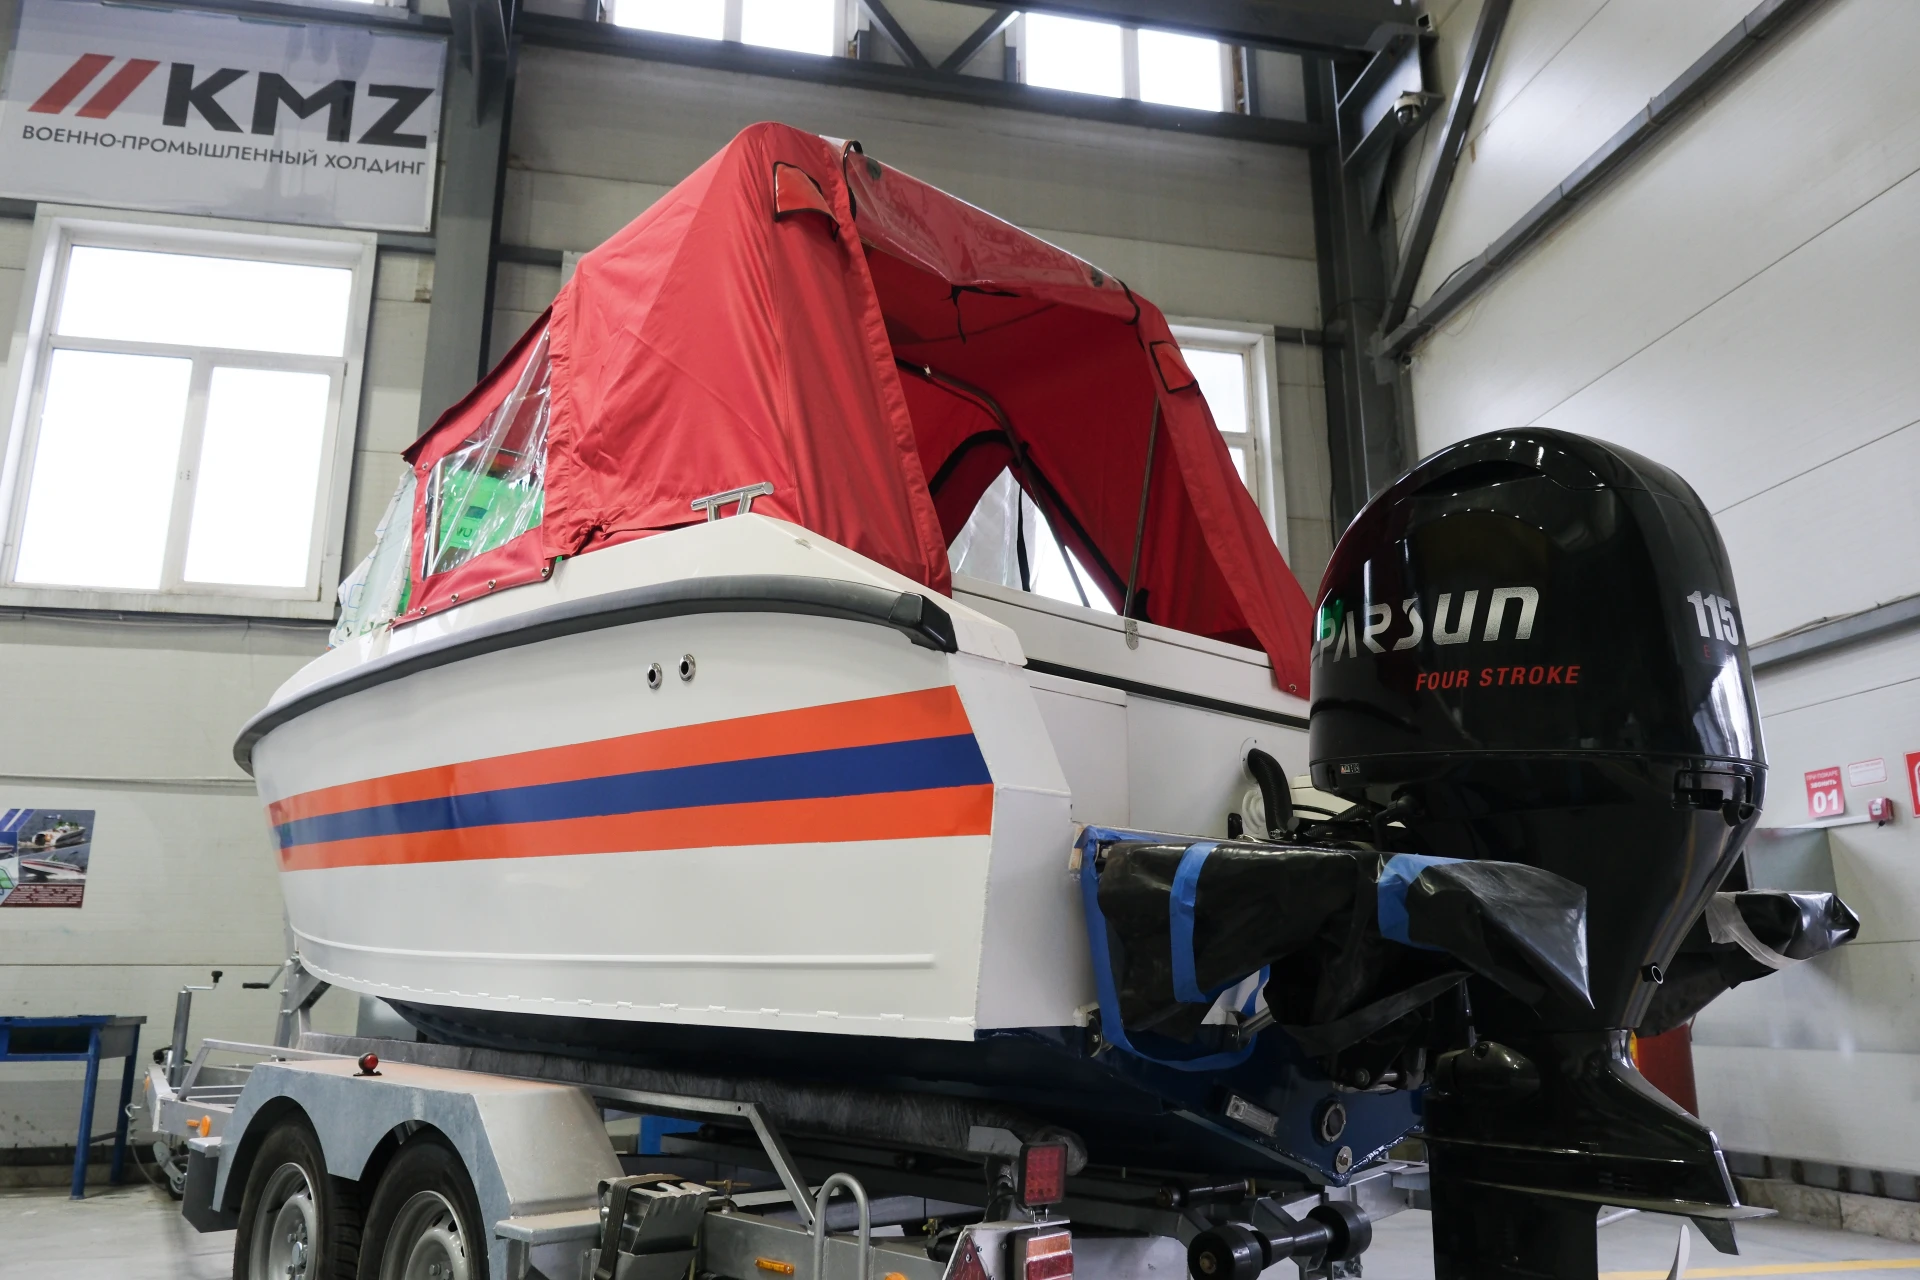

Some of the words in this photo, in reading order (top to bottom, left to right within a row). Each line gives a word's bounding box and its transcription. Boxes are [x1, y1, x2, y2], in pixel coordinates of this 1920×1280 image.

[162, 62, 436, 149] KMZ
[22, 125, 318, 167] ВОЕННО-ПРОМЫШЛЕННЫЙ
[325, 154, 426, 176] ХОЛДИНГ
[1686, 590, 1739, 646] 115
[1415, 672, 1469, 692] FOUR
[1479, 665, 1581, 687] STROKE
[1813, 789, 1839, 813] 01
